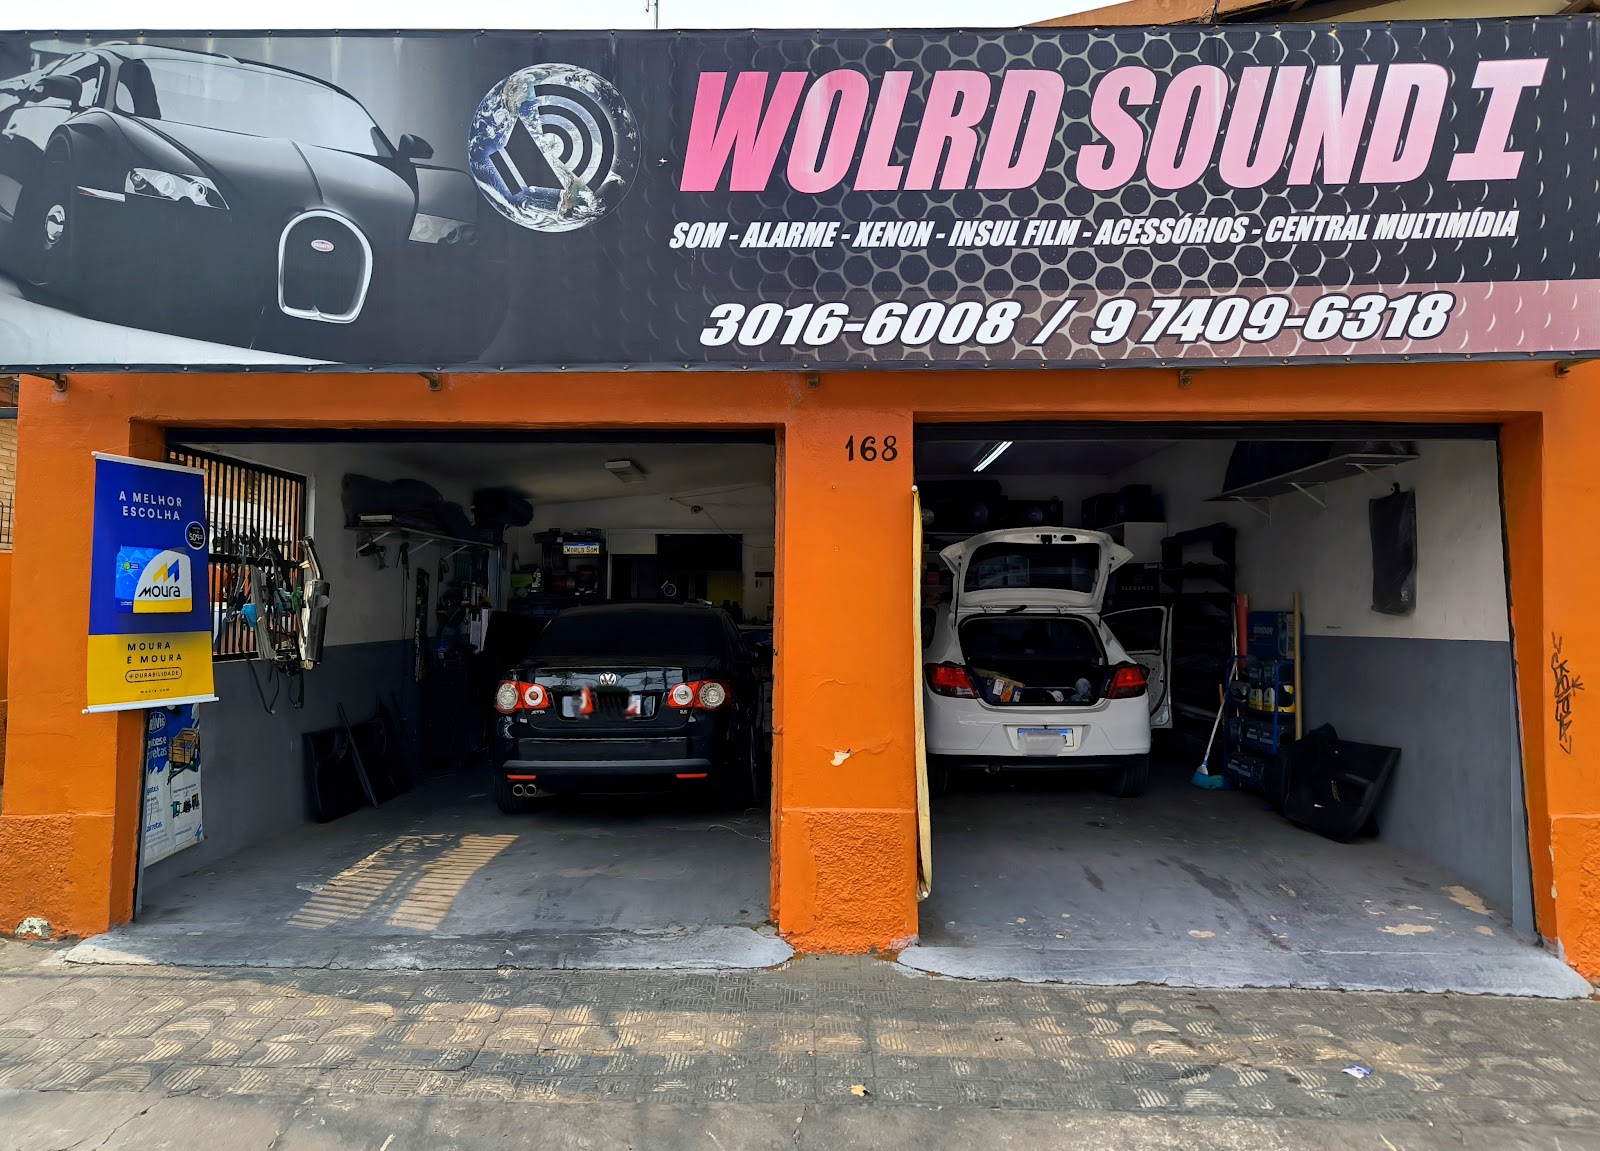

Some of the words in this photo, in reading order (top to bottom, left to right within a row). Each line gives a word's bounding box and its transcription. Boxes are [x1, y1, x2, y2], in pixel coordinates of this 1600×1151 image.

[680, 69, 1065, 193] WOLRD
[1076, 63, 1450, 190] SOUND
[1447, 58, 1549, 181] I
[669, 222, 728, 249] SOM
[740, 221, 840, 248] ALARME
[852, 221, 937, 248] XENON
[948, 220, 1018, 247] INSUL
[1021, 219, 1081, 246] FILM
[1094, 213, 1250, 246] ACESSÓRIOS
[1265, 213, 1371, 243] CENTRAL
[1373, 207, 1520, 240] MULTIMÍDIA
[699, 301, 1022, 347] 3016-6008
[1091, 298, 1137, 344] 9
[1142, 292, 1454, 343] 7409-6318
[845, 435, 898, 461] 168
[119, 491, 126, 501] A
[133, 492, 182, 507] MELHOR
[122, 506, 180, 520] ESCOLHA
[127, 642, 171, 651] MOURA
[127, 655, 132, 664] É
[140, 654, 182, 663] MOURA
